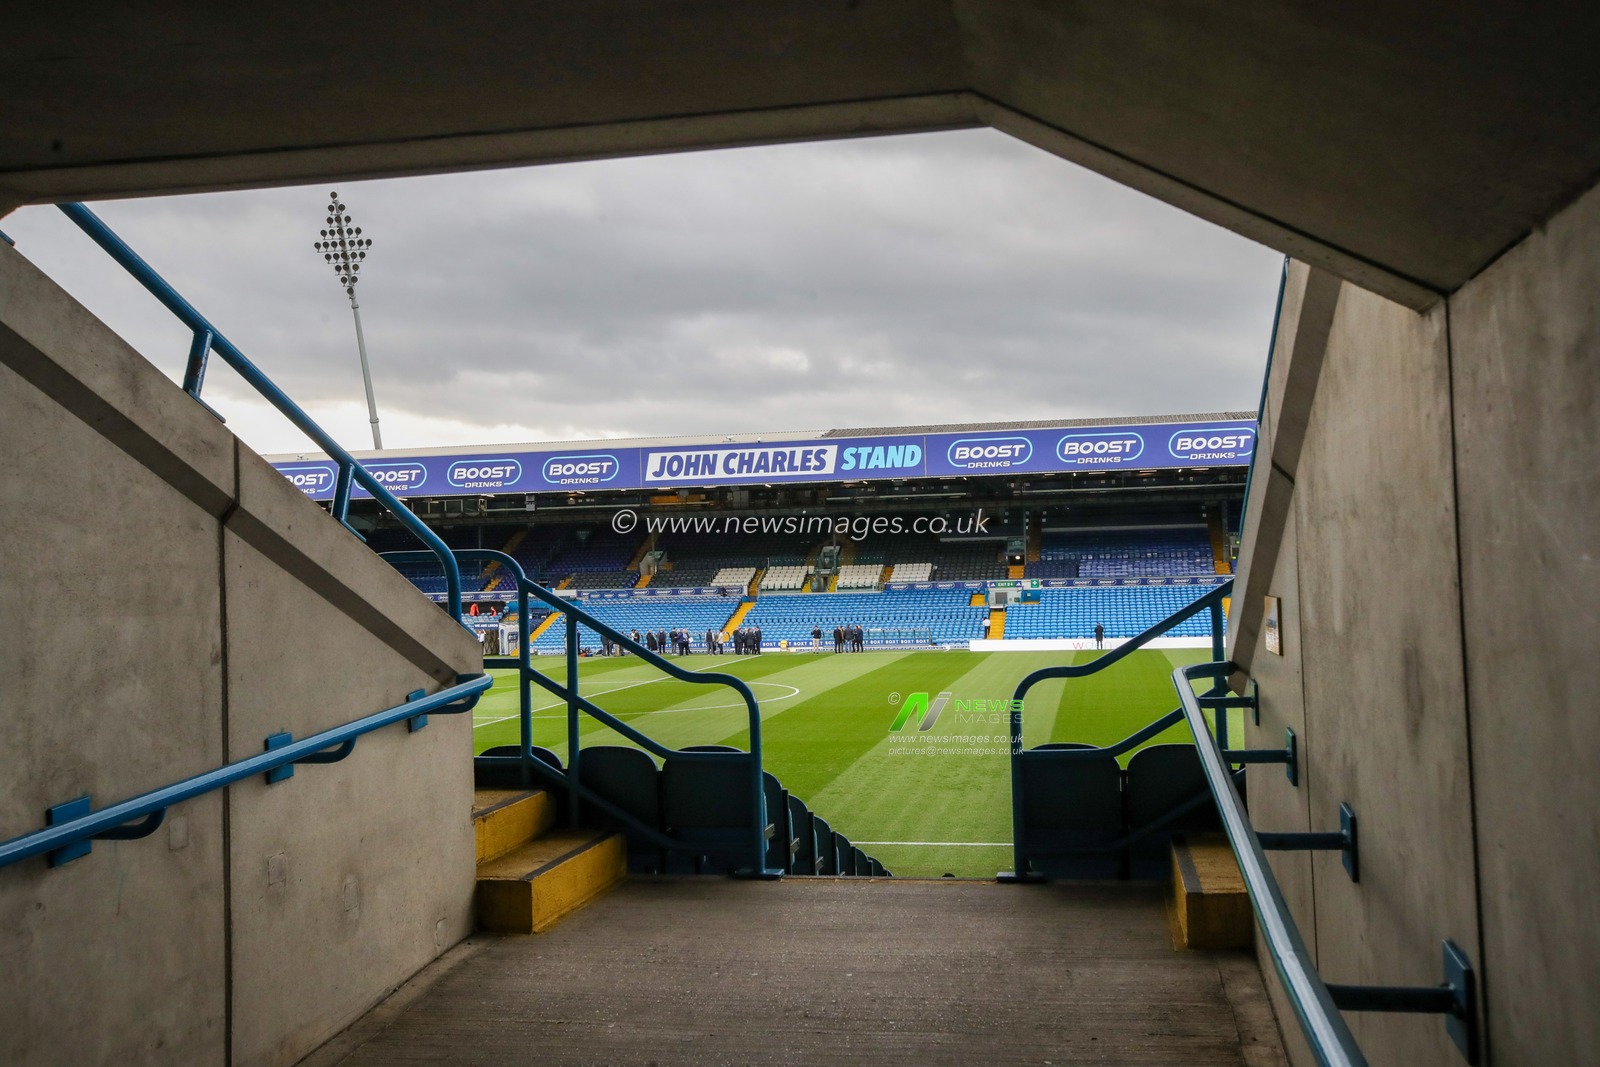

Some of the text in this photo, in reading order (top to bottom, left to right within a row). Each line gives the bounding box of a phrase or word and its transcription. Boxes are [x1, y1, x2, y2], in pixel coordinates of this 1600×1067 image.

[1063, 440, 1136, 455] BOOST
[1176, 435, 1251, 451] BOOST
[954, 444, 1025, 460] BOOST
[1189, 451, 1235, 460] DRINKS
[652, 444, 922, 478] JOHN CHARLES STAND
[967, 460, 1011, 469] DRINKS
[1076, 456, 1122, 465] DRINKS
[453, 466, 515, 479] BOOST
[549, 462, 612, 476] BOOST
[368, 470, 420, 482] OOST
[560, 477, 599, 485] DRINKS
